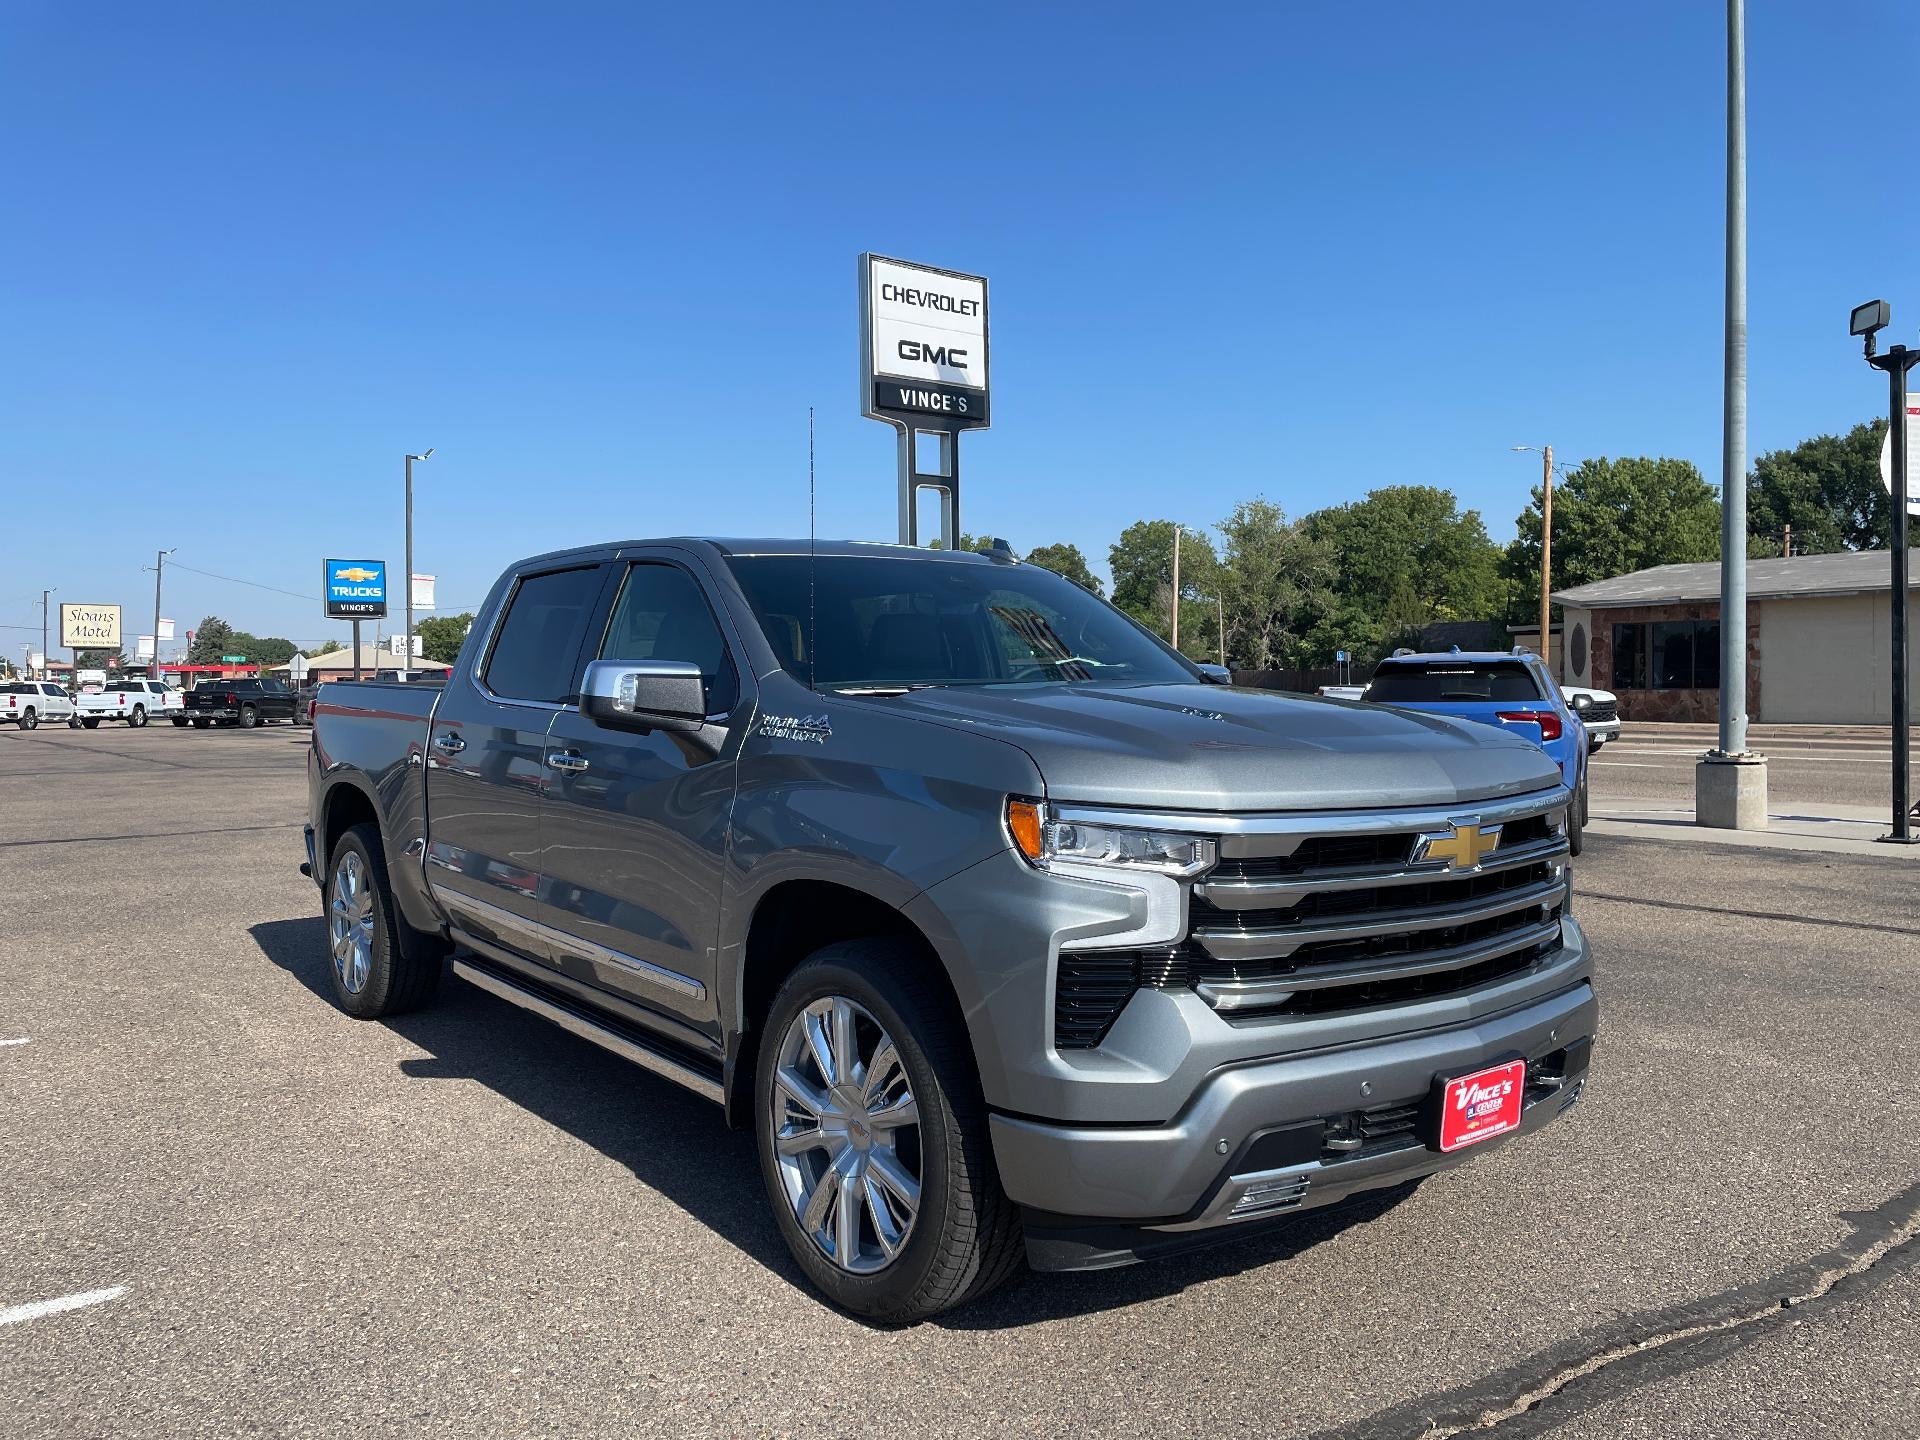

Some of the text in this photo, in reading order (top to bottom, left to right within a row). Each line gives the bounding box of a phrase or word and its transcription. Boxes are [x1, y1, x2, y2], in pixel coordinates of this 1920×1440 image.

[882, 283, 979, 317] CHEVROLET
[898, 339, 968, 369] GMC
[900, 388, 968, 413] VINCE'S
[332, 586, 382, 597] TRUCKS
[69, 607, 115, 622] Sloans
[340, 603, 374, 612] VINCE'S
[71, 624, 112, 638] Motel
[1455, 1080, 1514, 1110] VINCE'S
